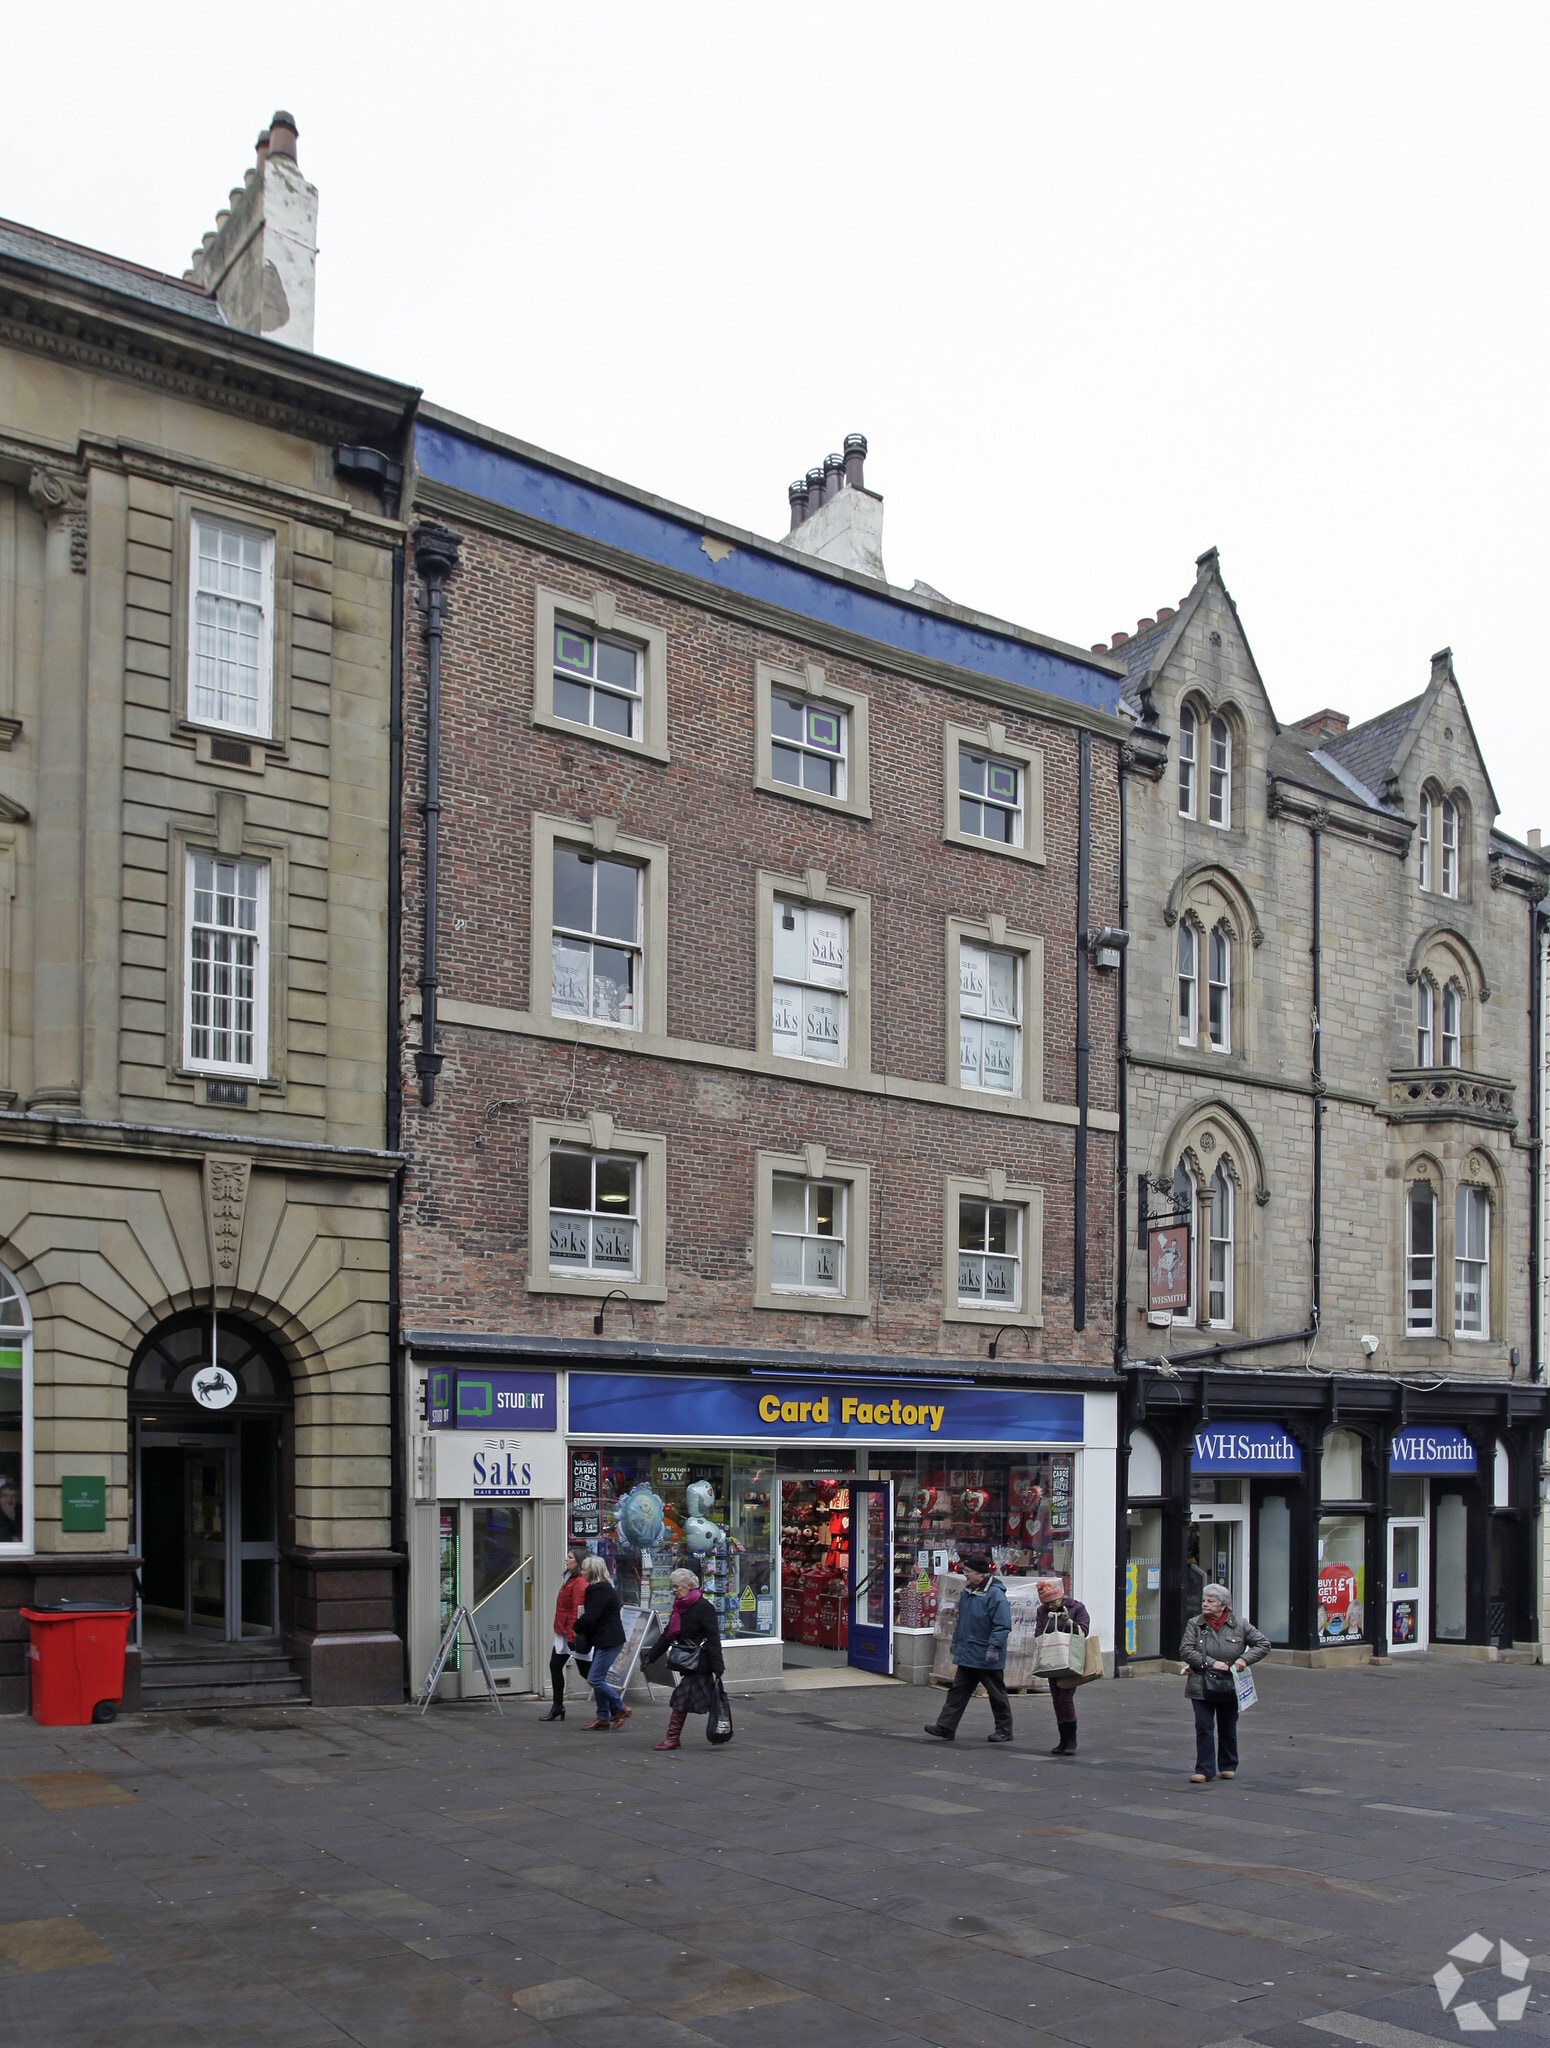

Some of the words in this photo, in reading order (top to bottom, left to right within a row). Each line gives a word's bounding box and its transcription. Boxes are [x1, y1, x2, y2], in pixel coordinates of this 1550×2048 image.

[812, 937, 843, 962] Saks
[773, 1008, 798, 1029] aks
[807, 1013, 838, 1037] Saks
[985, 1048, 1010, 1069] Saks
[550, 1229, 586, 1252] Saks
[595, 1234, 630, 1256] Saks
[959, 1269, 980, 1287] aks
[497, 1392, 545, 1409] STUDENT
[758, 1394, 829, 1422] Card
[841, 1397, 945, 1431] Factory
[1195, 1434, 1295, 1459] WHSmith
[1391, 1437, 1473, 1460] WHSmith
[473, 1451, 532, 1486] Saks
[573, 1466, 597, 1476] CARDS
[1317, 1579, 1333, 1588] BUY
[1338, 1577, 1355, 1603] £1
[1318, 1587, 1333, 1596] GET
[1321, 1595, 1338, 1604] FOR
[480, 1632, 514, 1653] Saks
